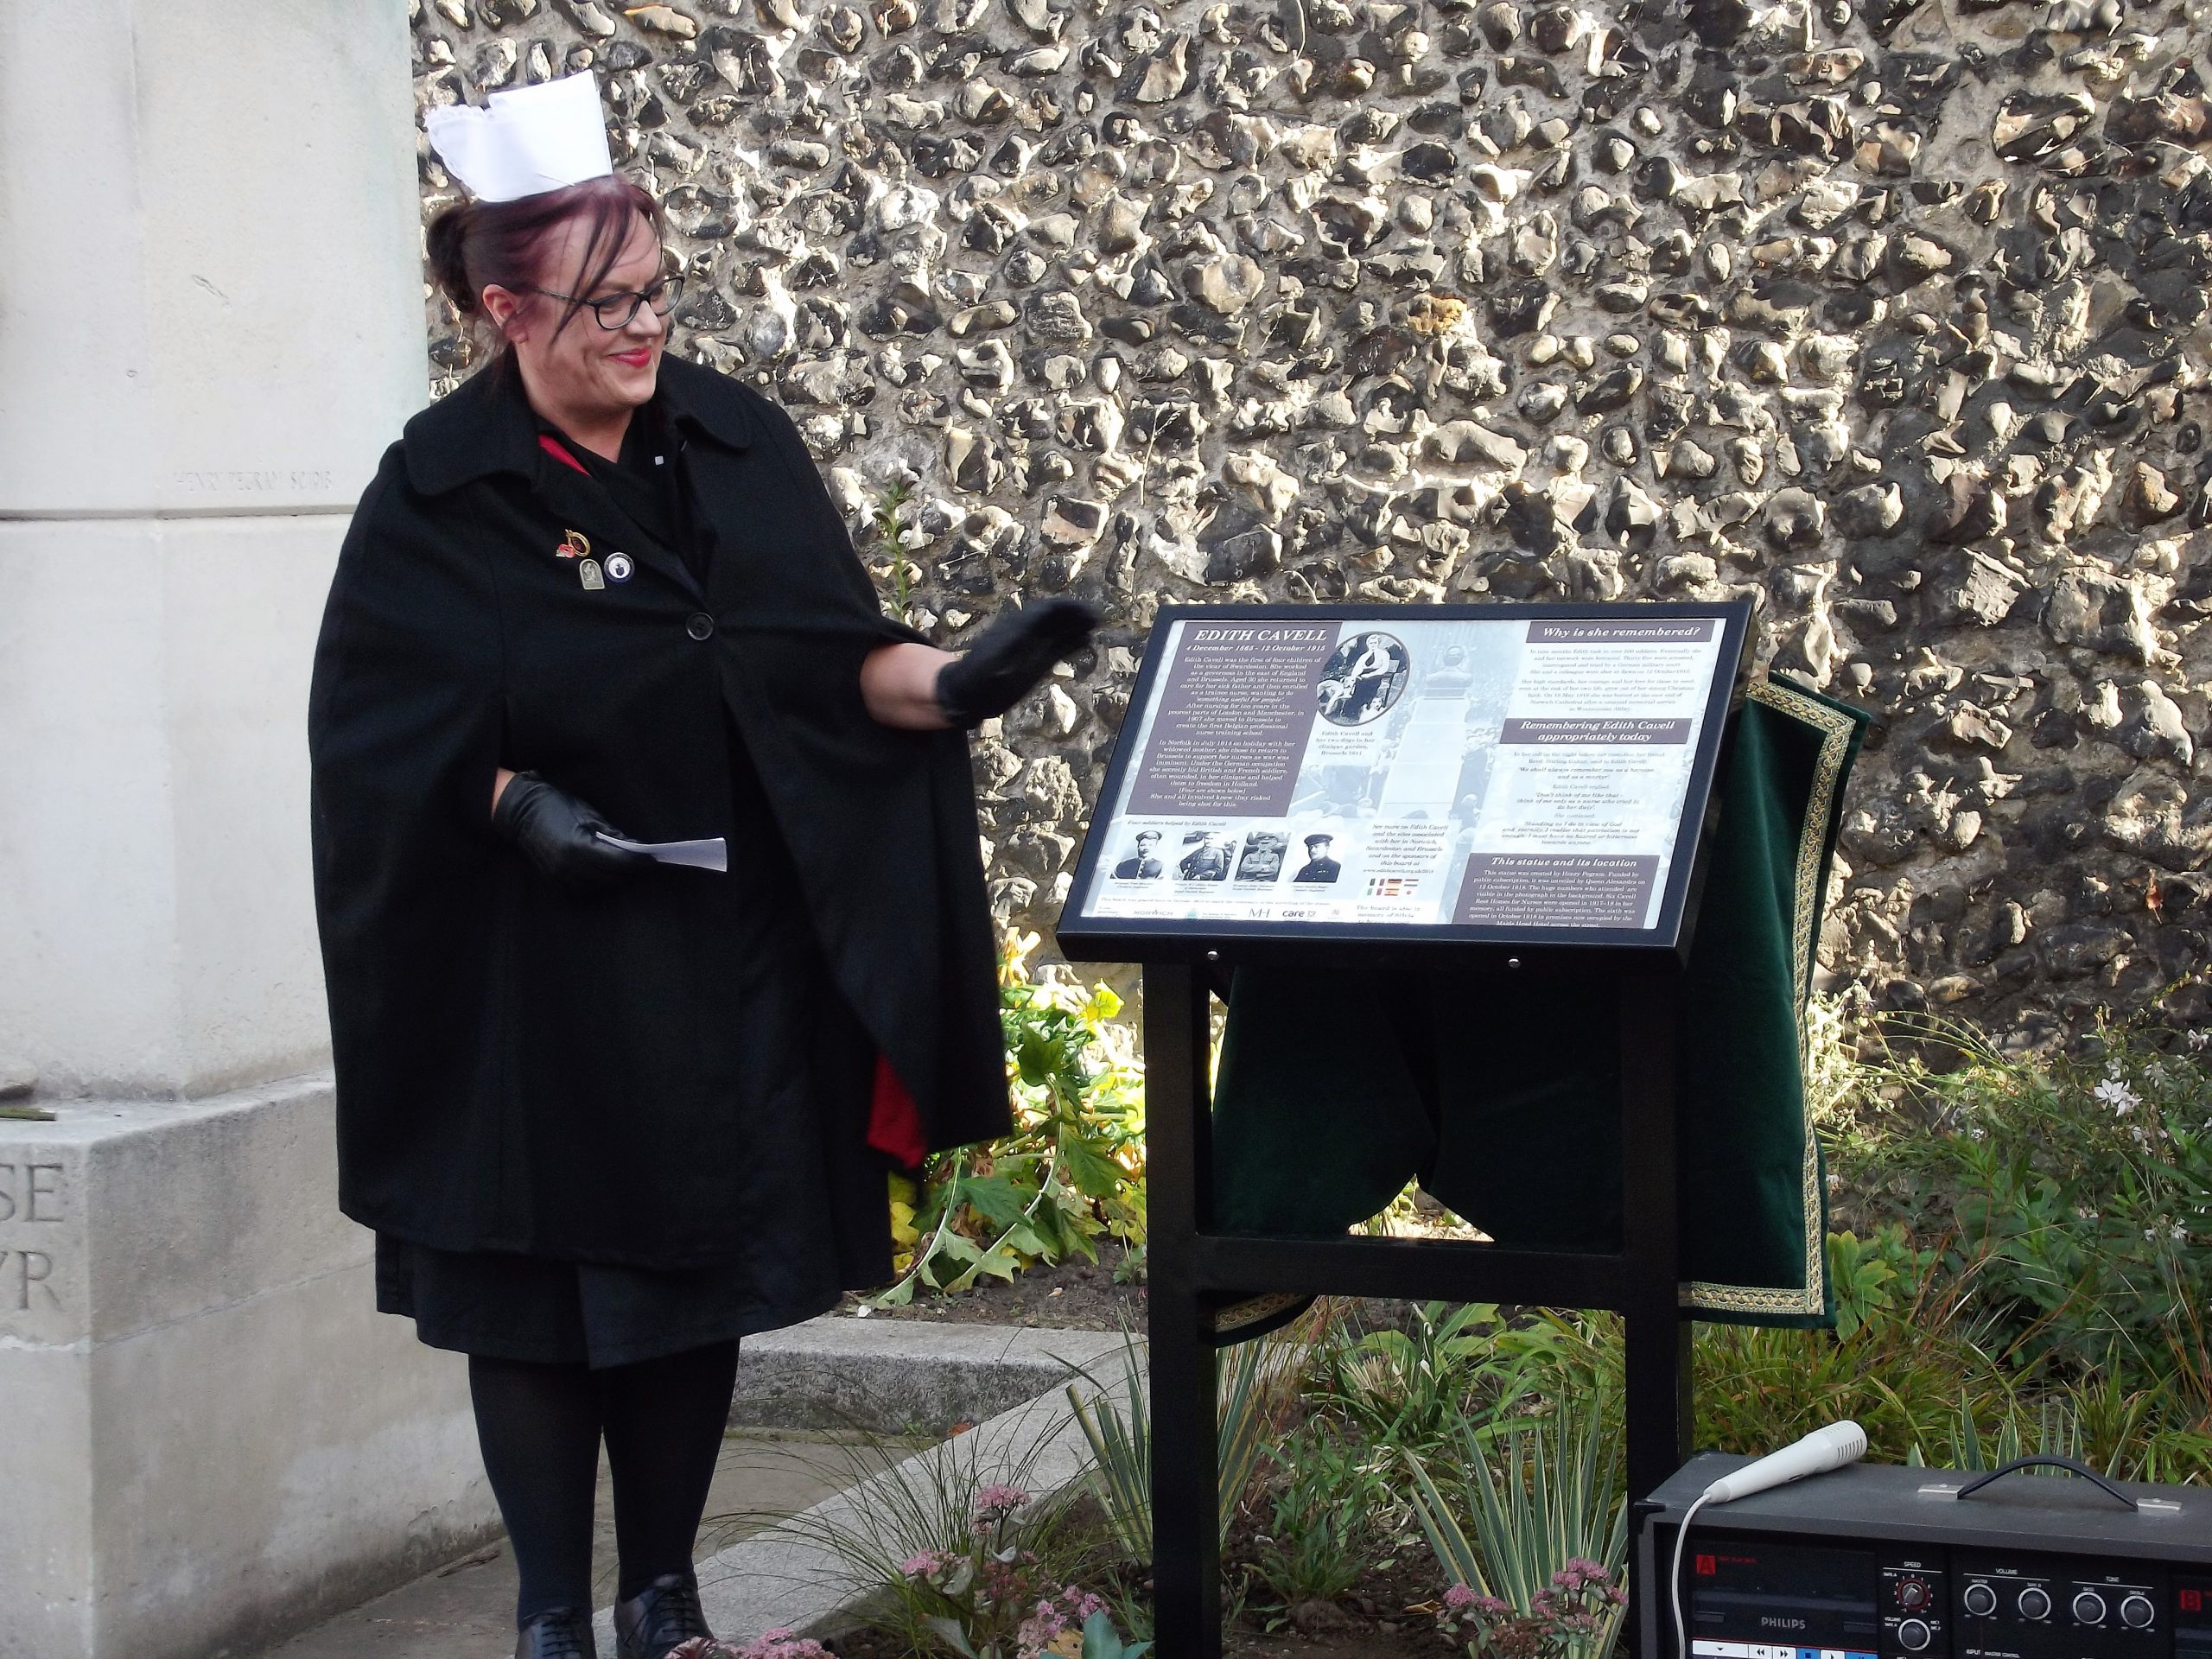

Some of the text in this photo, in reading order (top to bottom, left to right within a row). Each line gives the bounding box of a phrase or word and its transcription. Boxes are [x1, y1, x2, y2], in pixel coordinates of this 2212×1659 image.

[1194, 629, 1327, 641] EDITH CAVELL
[1544, 626, 1700, 638] Why is she remembered?
[1520, 721, 1675, 731] Remembering Edith Cavell
[1537, 732, 1652, 742] appropriately today
[1491, 857, 1515, 865] This
[1592, 858, 1636, 867] location
[1282, 909, 1305, 918] care
[0, 1250, 67, 1312] R
[1761, 1617, 1806, 1630] PHILIPS
